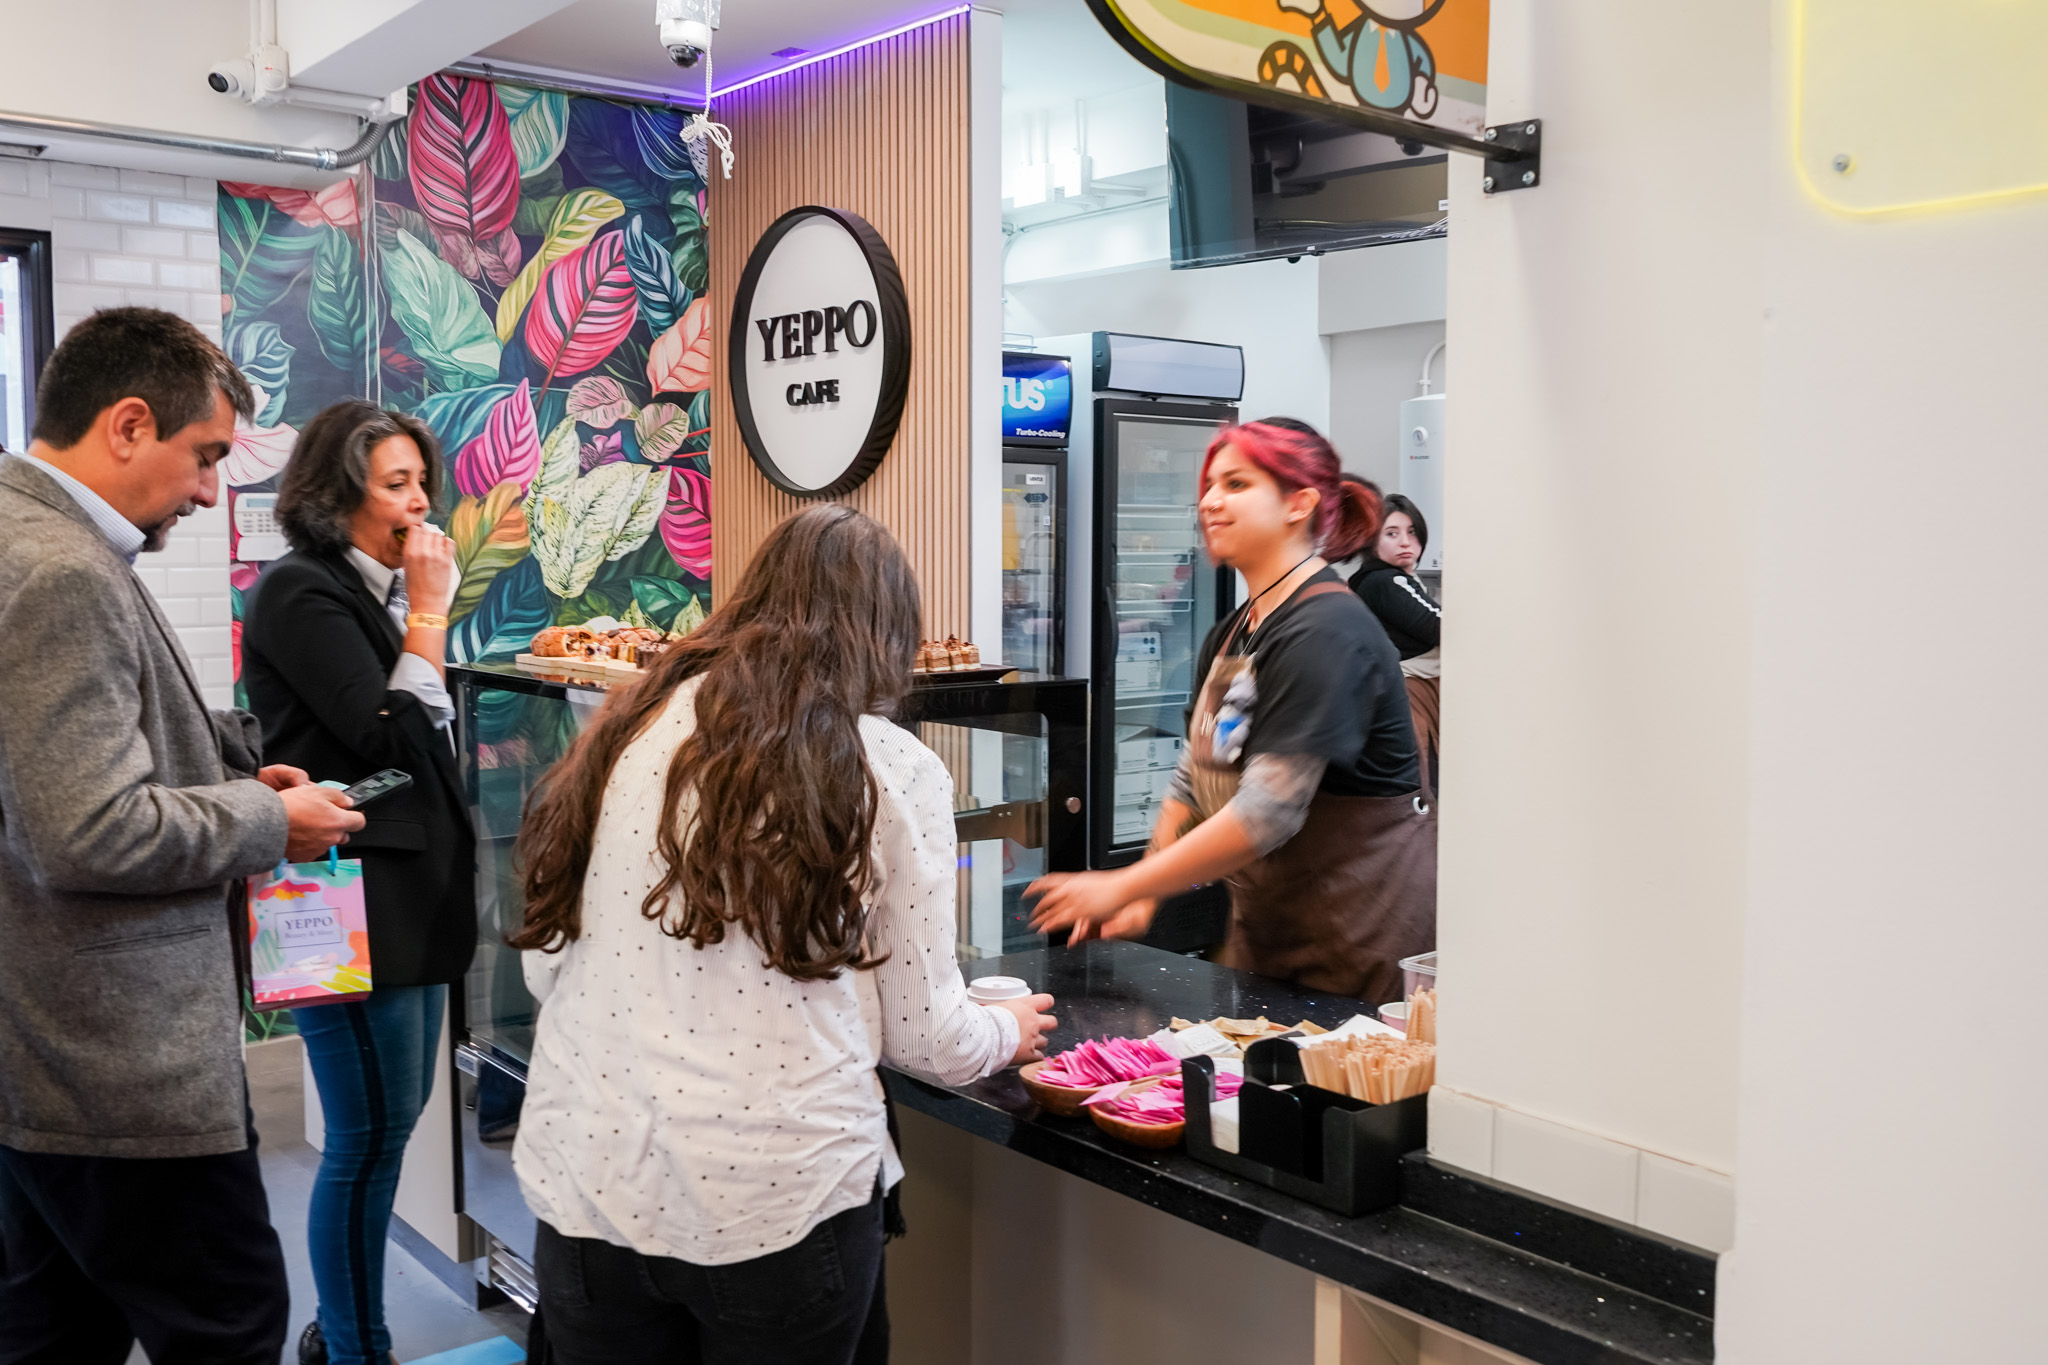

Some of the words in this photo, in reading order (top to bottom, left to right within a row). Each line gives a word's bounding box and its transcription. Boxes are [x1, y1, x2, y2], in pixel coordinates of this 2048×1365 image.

[755, 300, 877, 362] YEPPO
[786, 379, 840, 406] CAFE
[1016, 428, 1066, 439] Turbo-Cooling
[285, 916, 333, 930] YEPPO
